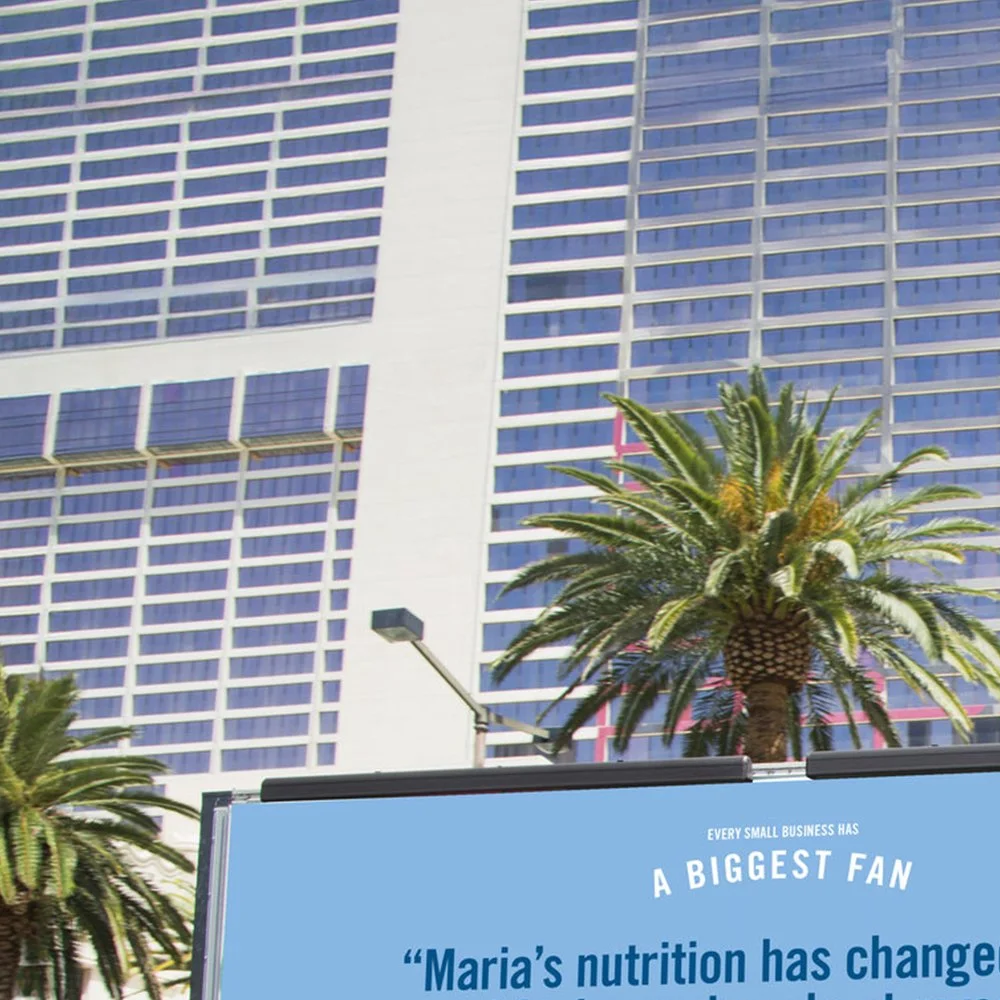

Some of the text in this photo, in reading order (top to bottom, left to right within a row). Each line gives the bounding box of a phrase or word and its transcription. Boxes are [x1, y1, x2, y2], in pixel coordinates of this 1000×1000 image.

[708, 823, 859, 840] EVERY SMALL BUSINESS HAS
[654, 849, 912, 897] A BIGGEST FAN
[577, 941, 745, 987] nutrition
[762, 939, 830, 982] has
